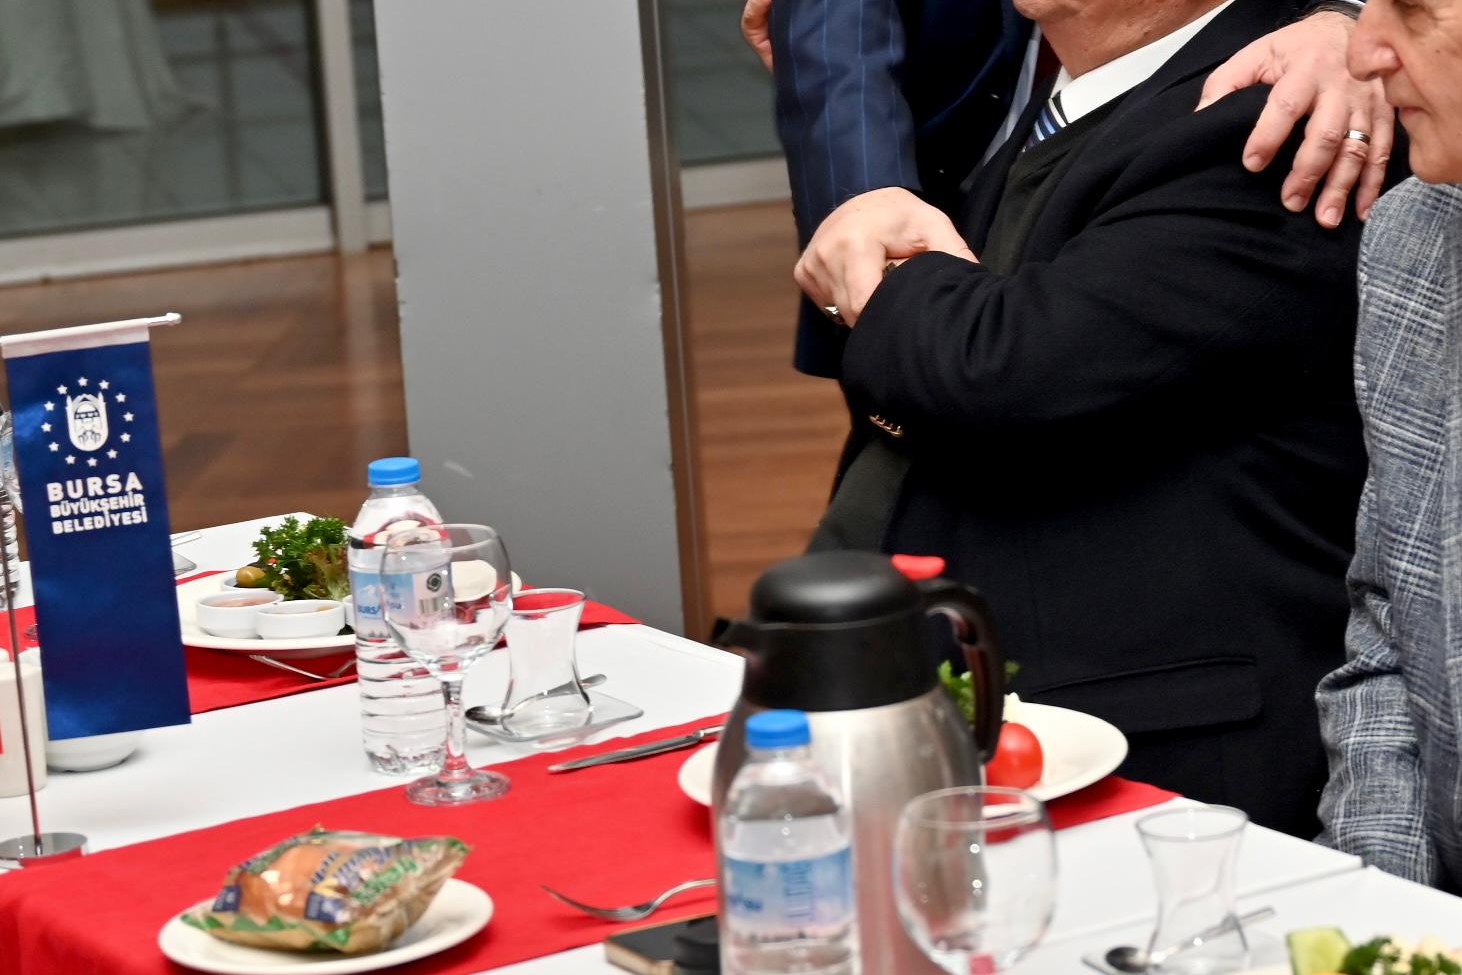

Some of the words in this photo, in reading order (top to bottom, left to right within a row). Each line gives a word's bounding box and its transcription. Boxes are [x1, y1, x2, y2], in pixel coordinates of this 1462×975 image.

[47, 471, 144, 502] BURSA
[50, 491, 146, 519] BÜYÜKŞEHİR
[52, 506, 148, 535] BELEDİYESİ
